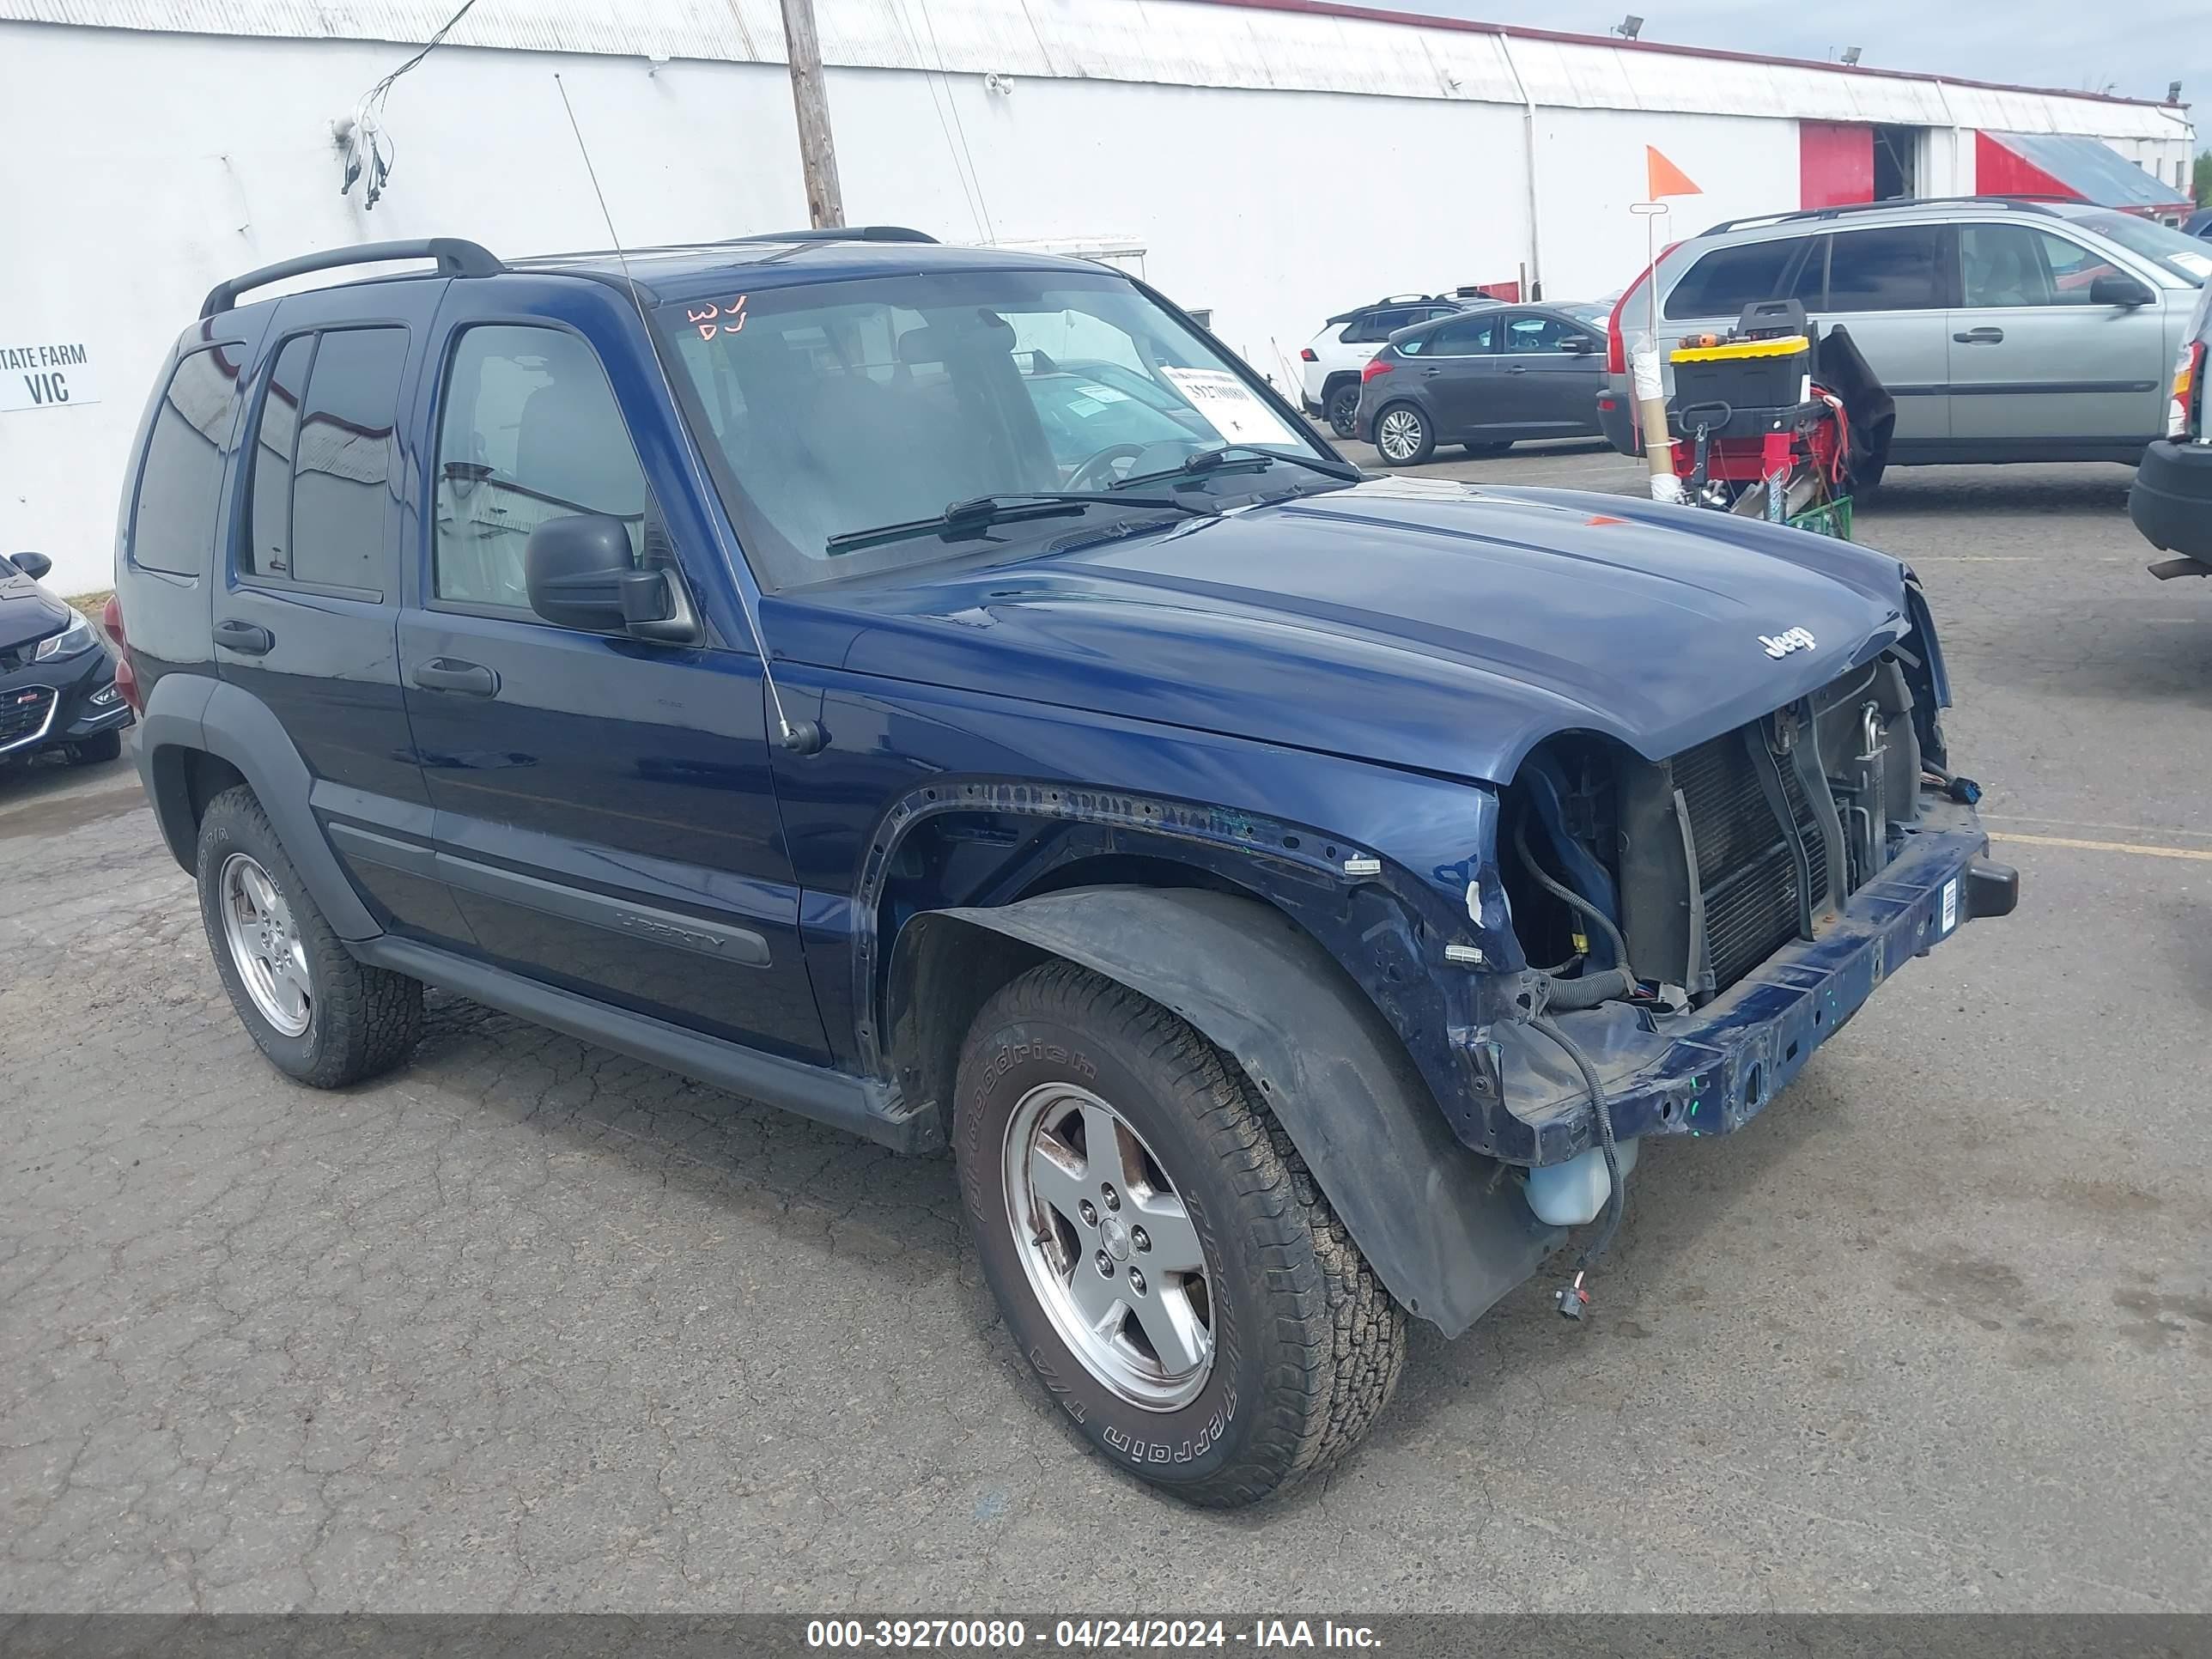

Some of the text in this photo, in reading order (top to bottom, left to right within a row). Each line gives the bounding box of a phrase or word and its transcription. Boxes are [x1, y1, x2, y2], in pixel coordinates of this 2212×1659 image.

[0, 343, 88, 370] TATE FARM
[24, 372, 70, 404] VIC
[1757, 626, 1817, 660] Jeep
[1030, 1346, 1087, 1425] T/A
